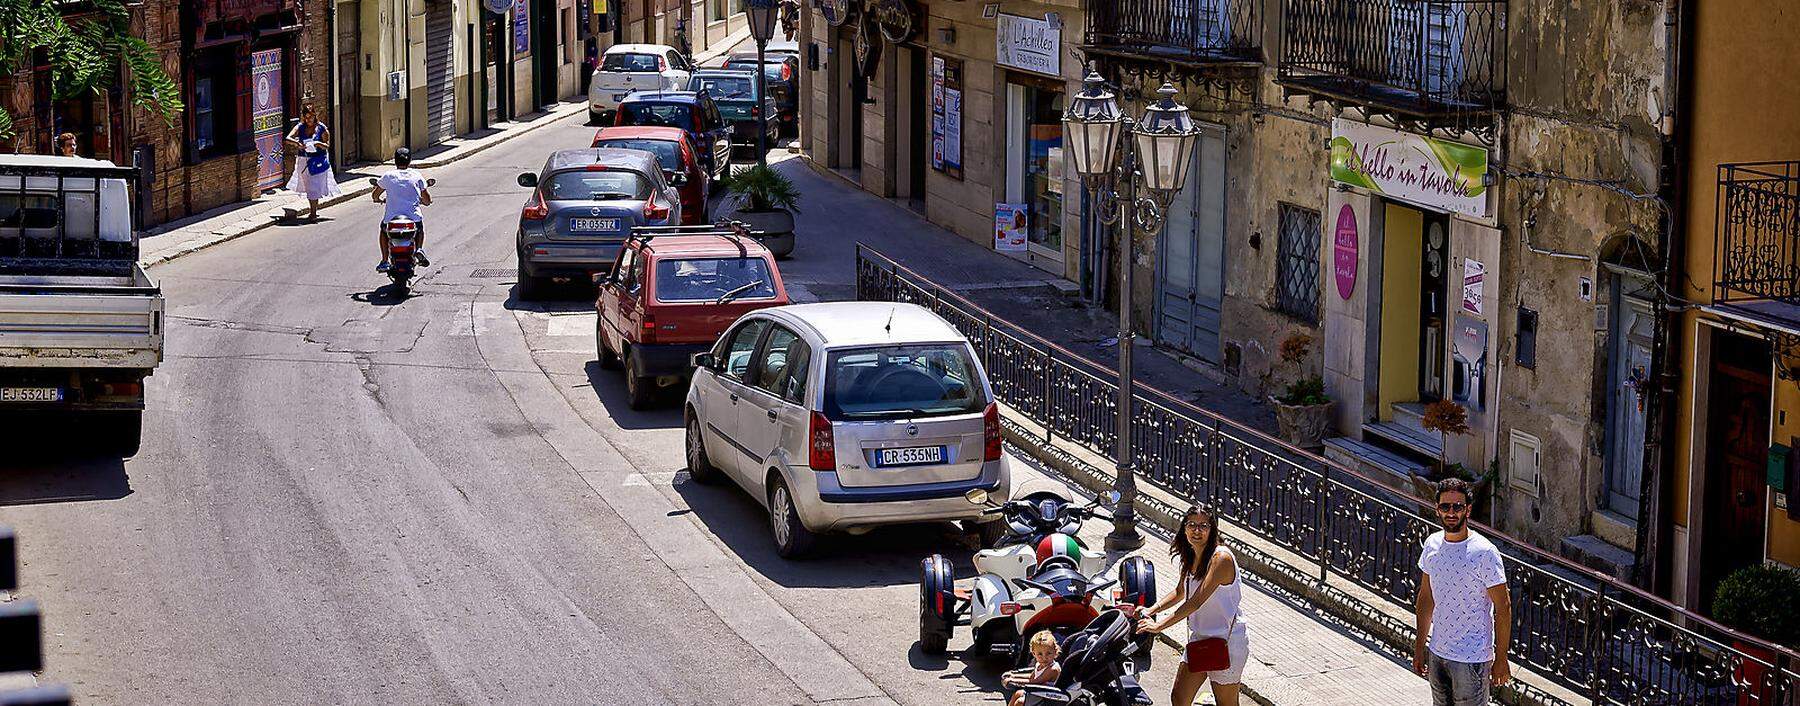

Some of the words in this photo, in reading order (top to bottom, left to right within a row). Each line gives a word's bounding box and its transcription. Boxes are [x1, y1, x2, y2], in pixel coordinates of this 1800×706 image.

[1344, 141, 1358, 171] il
[1360, 142, 1395, 181] bello
[1397, 158, 1418, 187] in
[1418, 162, 1472, 198] tavola
